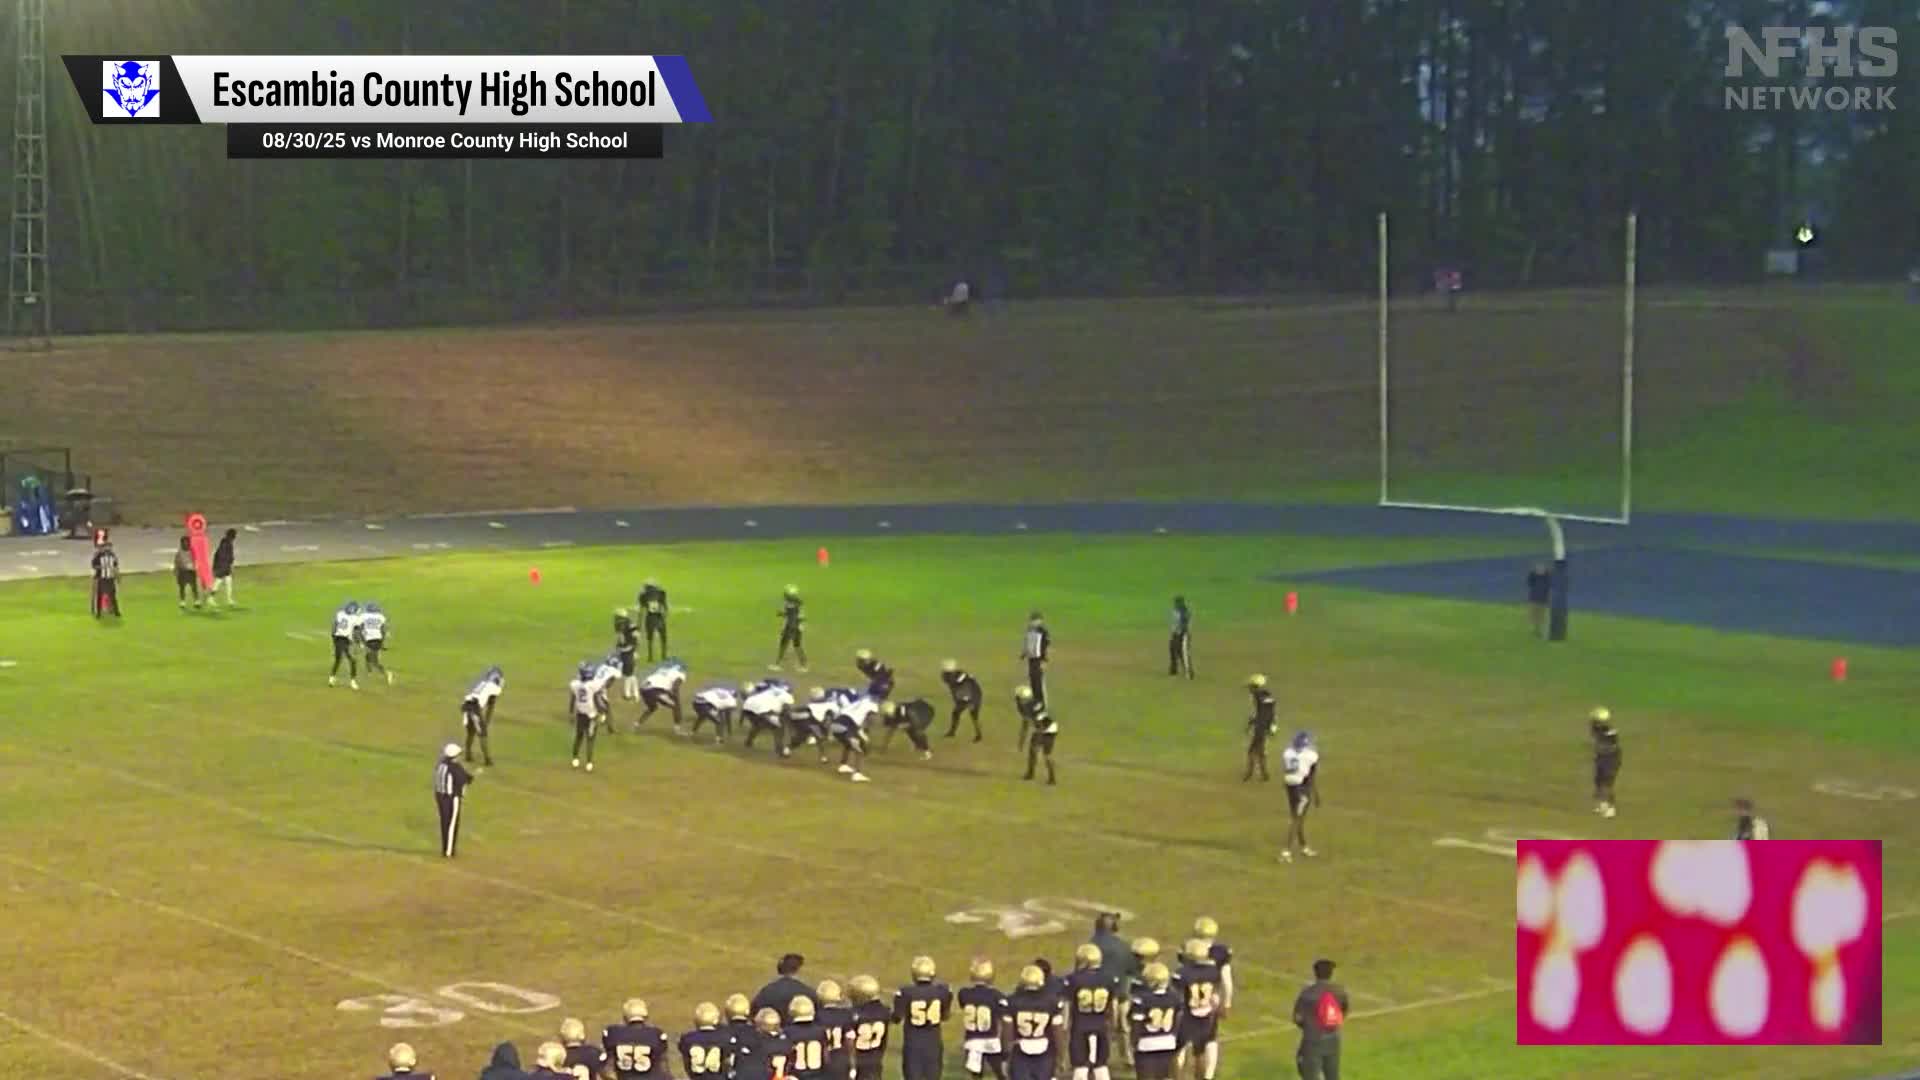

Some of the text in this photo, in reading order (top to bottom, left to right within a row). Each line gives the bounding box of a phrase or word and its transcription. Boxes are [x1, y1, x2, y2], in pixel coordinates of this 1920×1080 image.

[336, 981, 561, 1028] 30
[911, 999, 941, 1026] 54
[1016, 1011, 1050, 1038] 57
[616, 1045, 651, 1072] 55
[690, 1045, 721, 1073] 24
